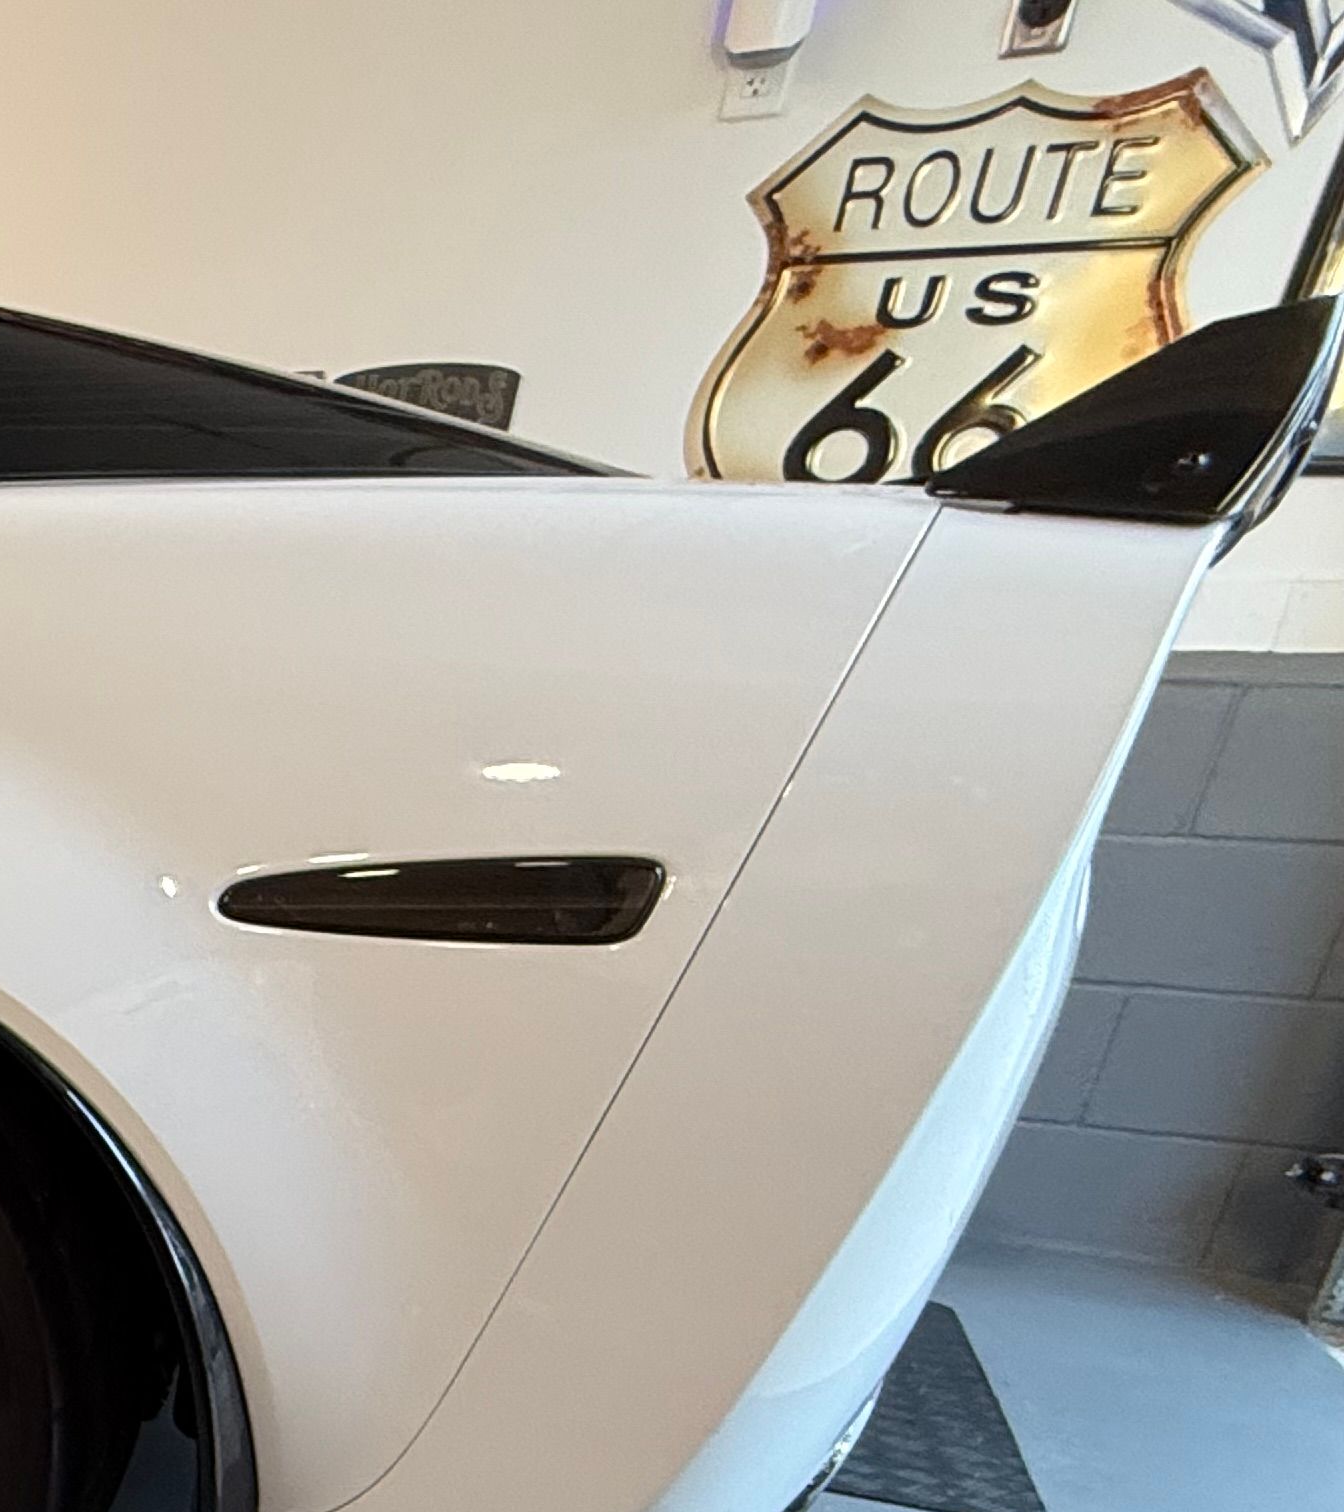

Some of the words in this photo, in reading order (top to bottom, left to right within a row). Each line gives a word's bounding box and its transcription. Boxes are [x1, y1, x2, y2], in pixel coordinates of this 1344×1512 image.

[833, 134, 1161, 233] ROUTE
[875, 269, 1042, 330] US
[782, 342, 1044, 485] 66
